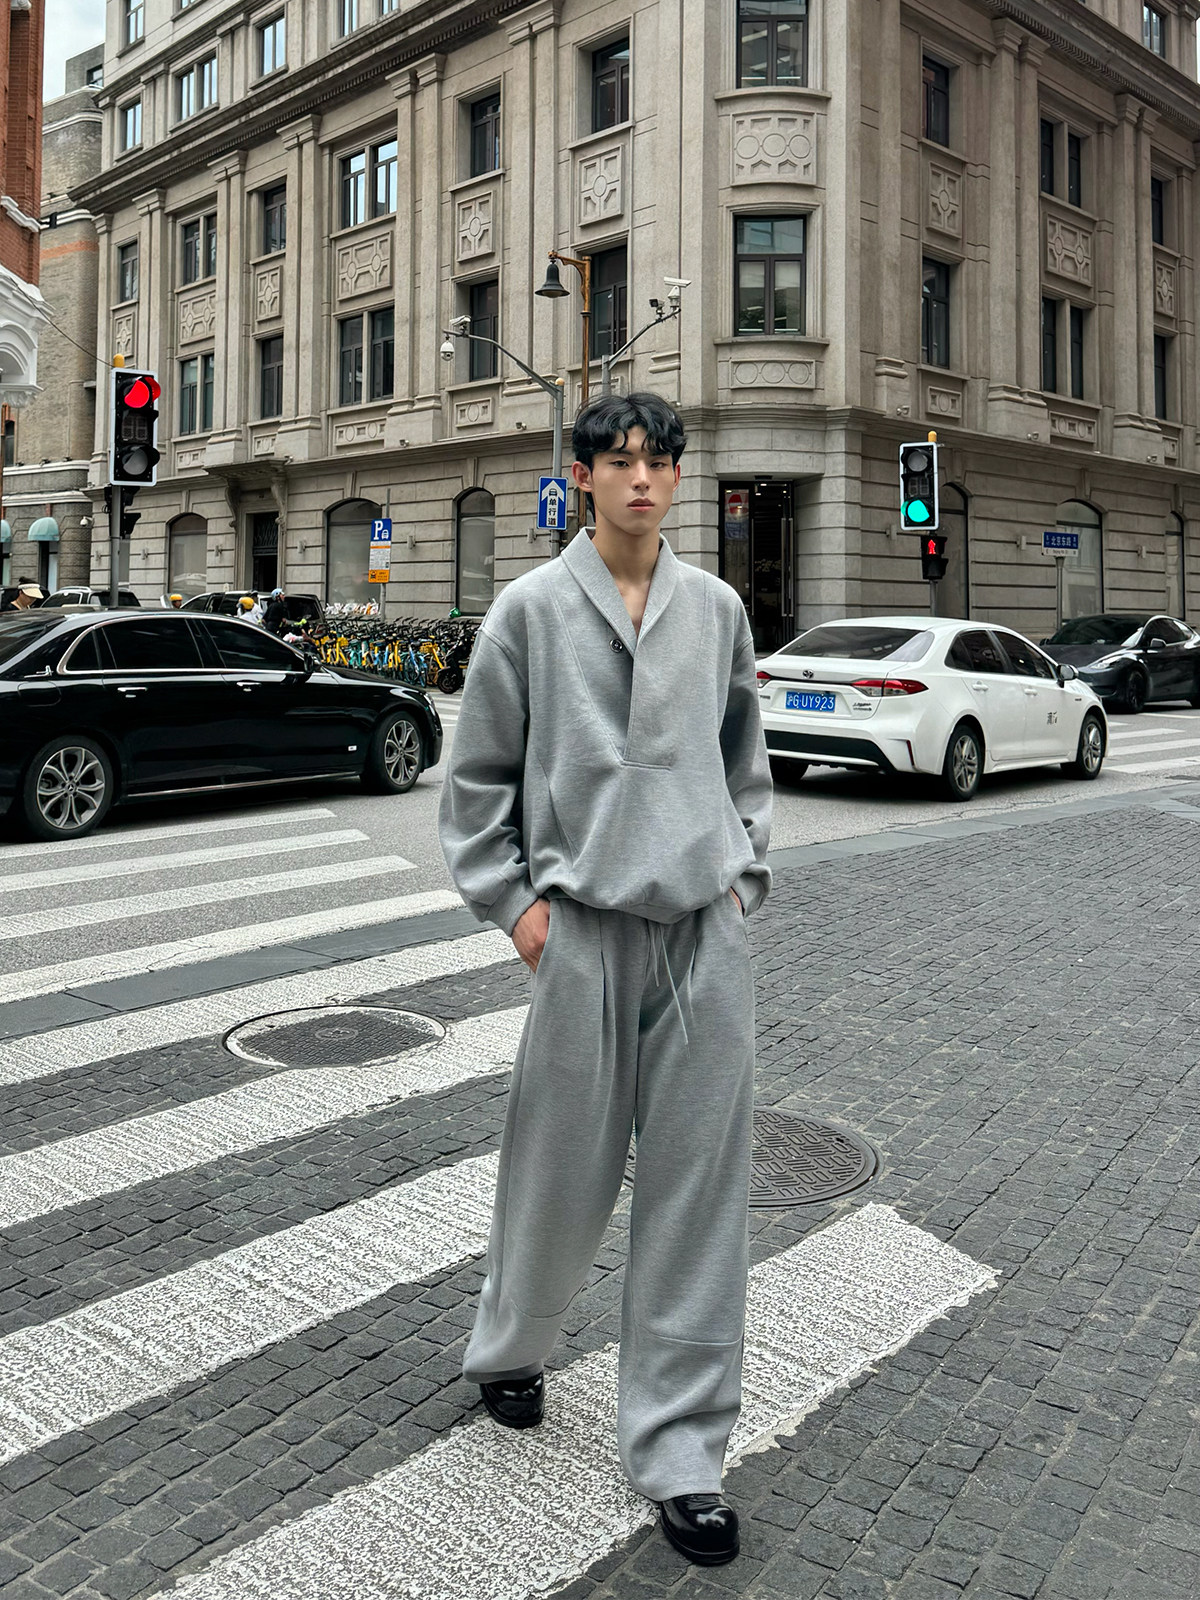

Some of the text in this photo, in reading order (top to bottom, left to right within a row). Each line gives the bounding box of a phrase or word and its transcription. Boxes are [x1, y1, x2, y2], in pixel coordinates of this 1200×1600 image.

[548, 498, 557, 526] 单行道
[373, 520, 383, 540] P
